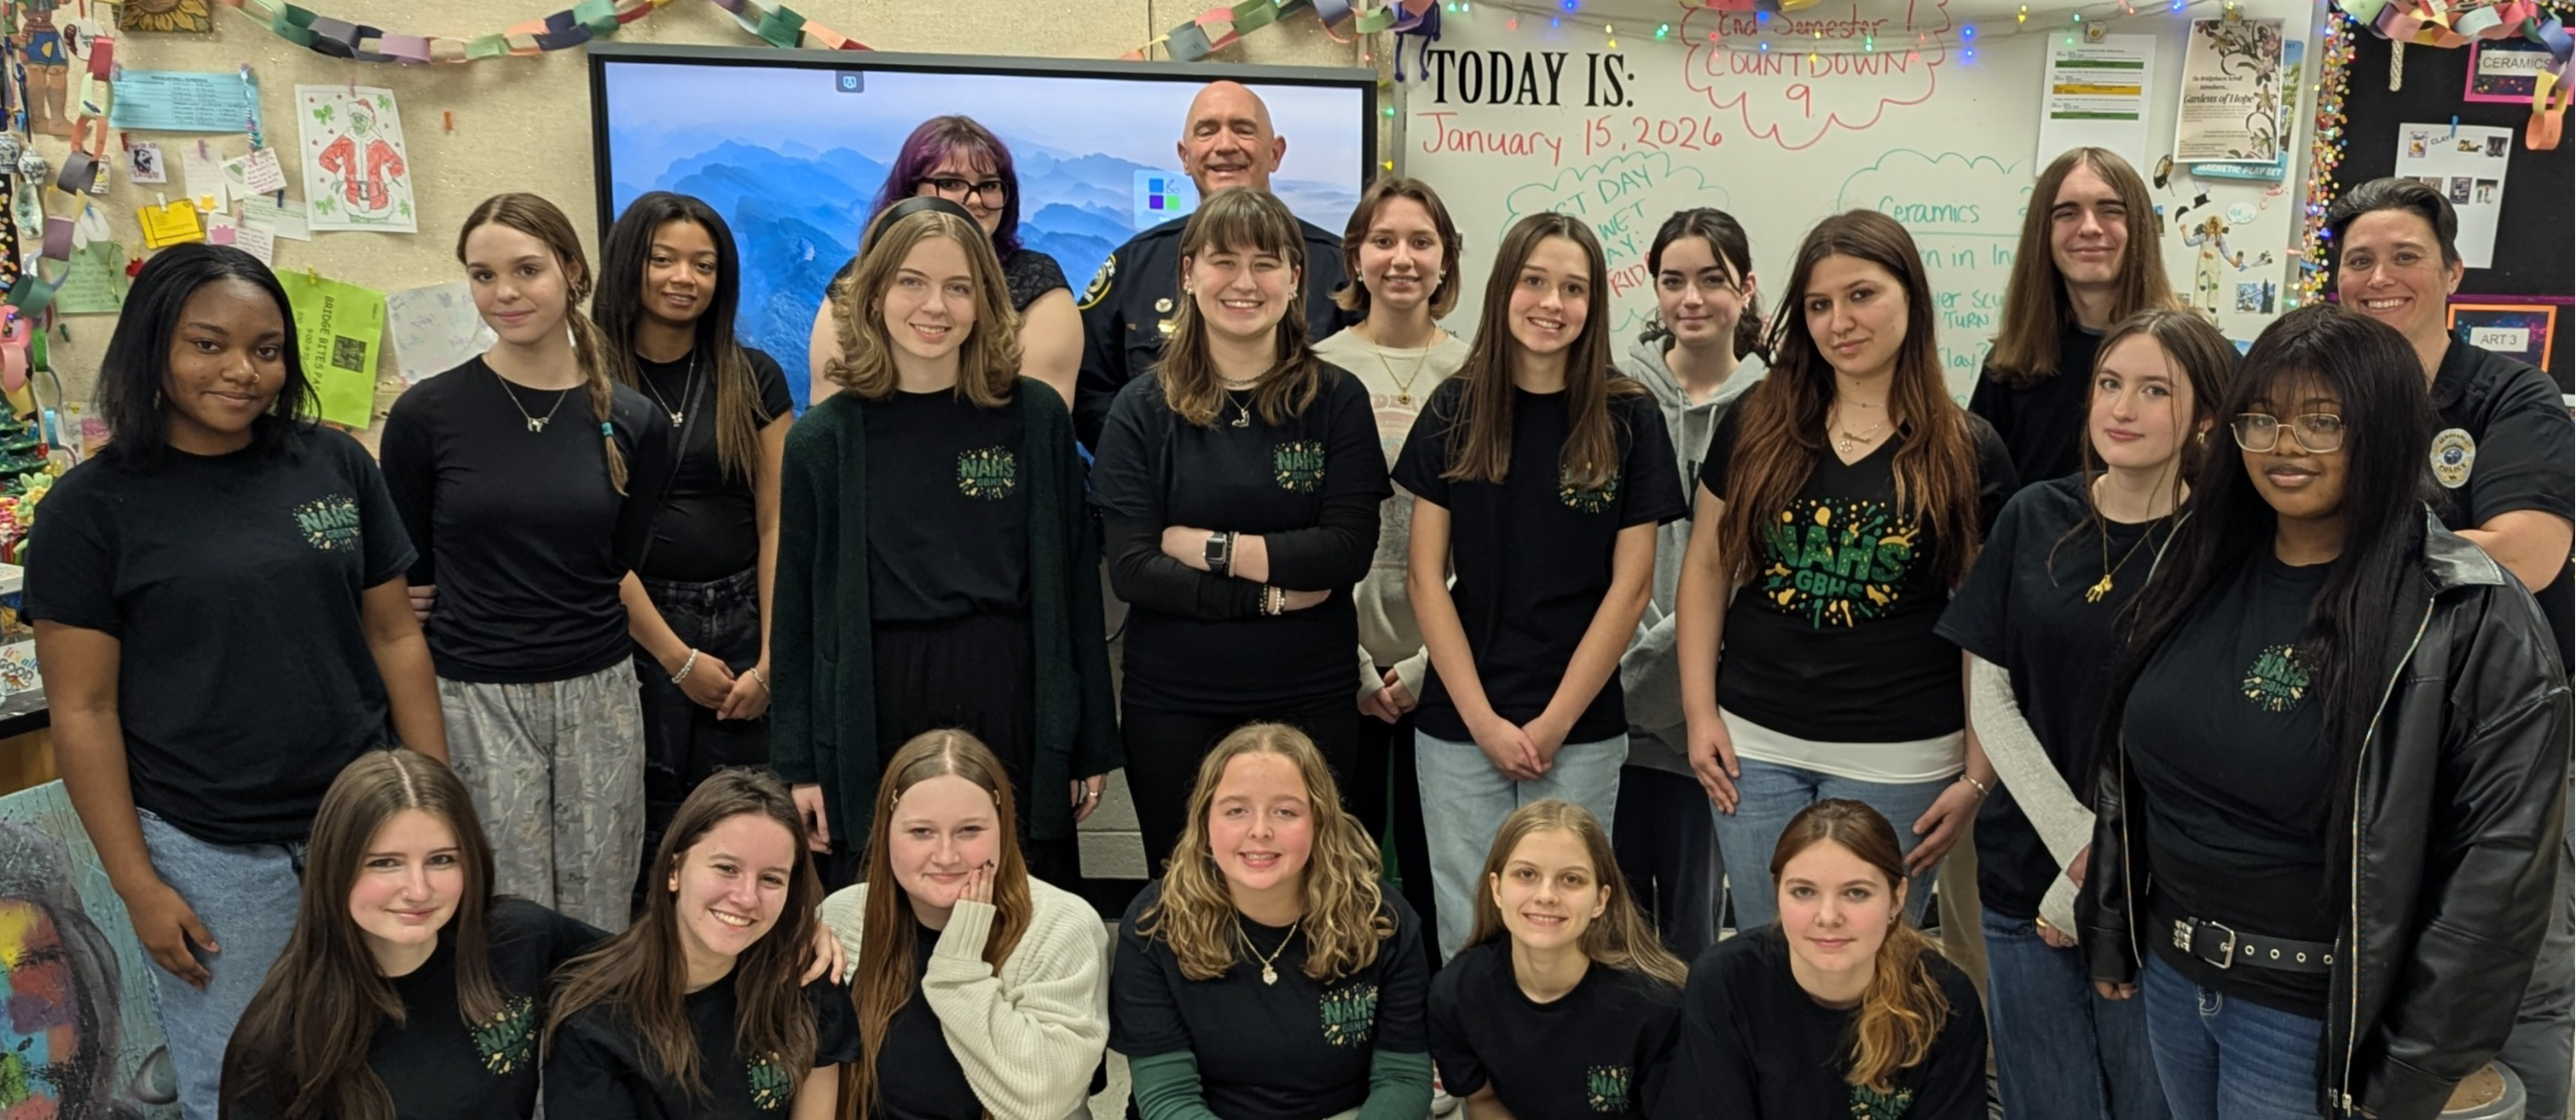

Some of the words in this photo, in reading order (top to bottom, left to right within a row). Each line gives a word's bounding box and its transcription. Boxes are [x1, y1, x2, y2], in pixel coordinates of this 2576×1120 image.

[1774, 3, 1890, 38] Semester
[1706, 44, 1911, 78] COUNTDOWN
[2481, 56, 2551, 70] CERAMICS
[1427, 49, 1569, 106] TODAY
[1583, 53, 1635, 108] IS:
[1786, 84, 1810, 119] 9
[2184, 94, 2218, 104] Gardens
[2219, 93, 2231, 105] of
[2230, 94, 2255, 105] Hope
[1416, 112, 1562, 167] January
[1632, 115, 1723, 152] 2026
[1597, 163, 1653, 205] DAY
[2196, 163, 2242, 175] MAGNETIC
[2266, 168, 2283, 177] SET
[1597, 198, 1646, 241] WET
[1878, 195, 1981, 224] Ceramics
[1951, 245, 1975, 270] in
[320, 295, 335, 336] BRIDGE
[2479, 334, 2508, 345] ART
[2509, 334, 2518, 345] 3
[315, 337, 329, 373] BITES
[960, 457, 1015, 479] NAHS
[1277, 450, 1323, 471] NAHS
[298, 507, 359, 533] NAHS
[1764, 518, 1912, 583] NAHS
[1794, 569, 1865, 598] GBHS
[2261, 678, 2291, 697] GBHS
